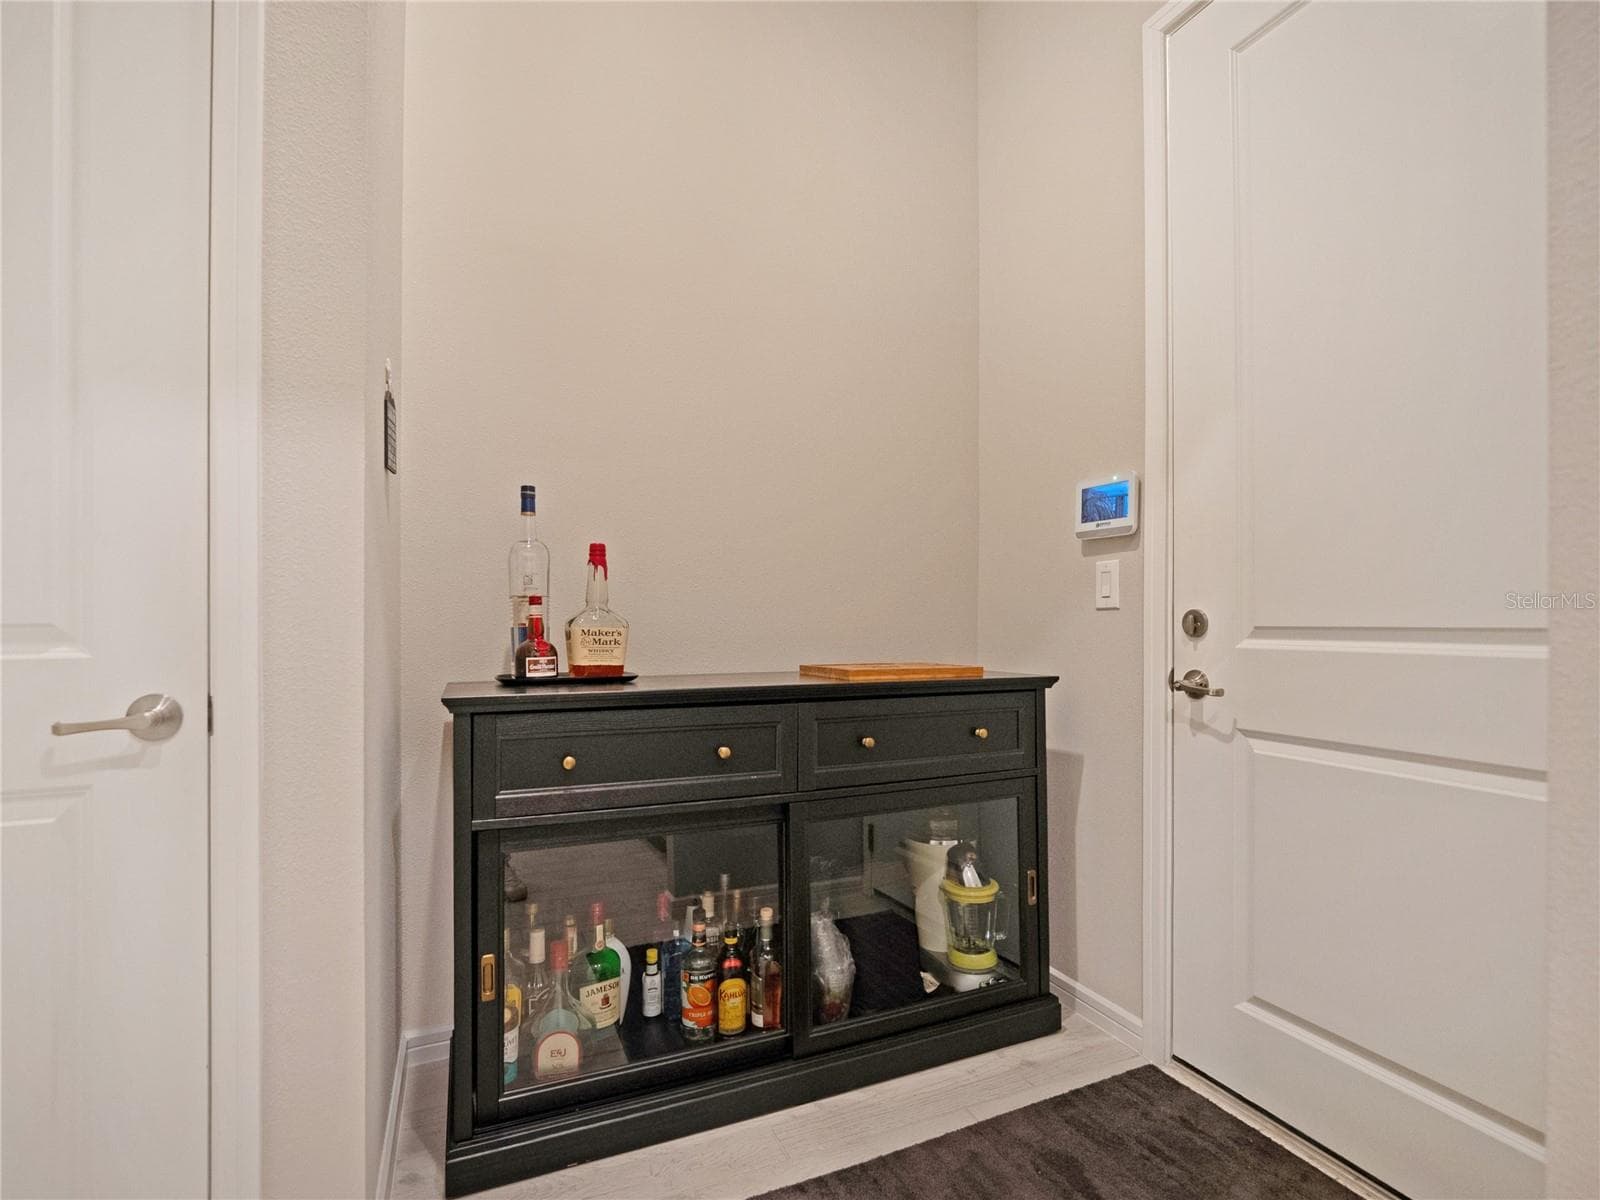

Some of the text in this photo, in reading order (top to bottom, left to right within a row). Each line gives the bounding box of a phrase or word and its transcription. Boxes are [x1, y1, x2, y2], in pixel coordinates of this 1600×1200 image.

[580, 629, 622, 637] Maker's
[592, 638, 621, 646] Mark
[550, 1048, 567, 1058] E&J
